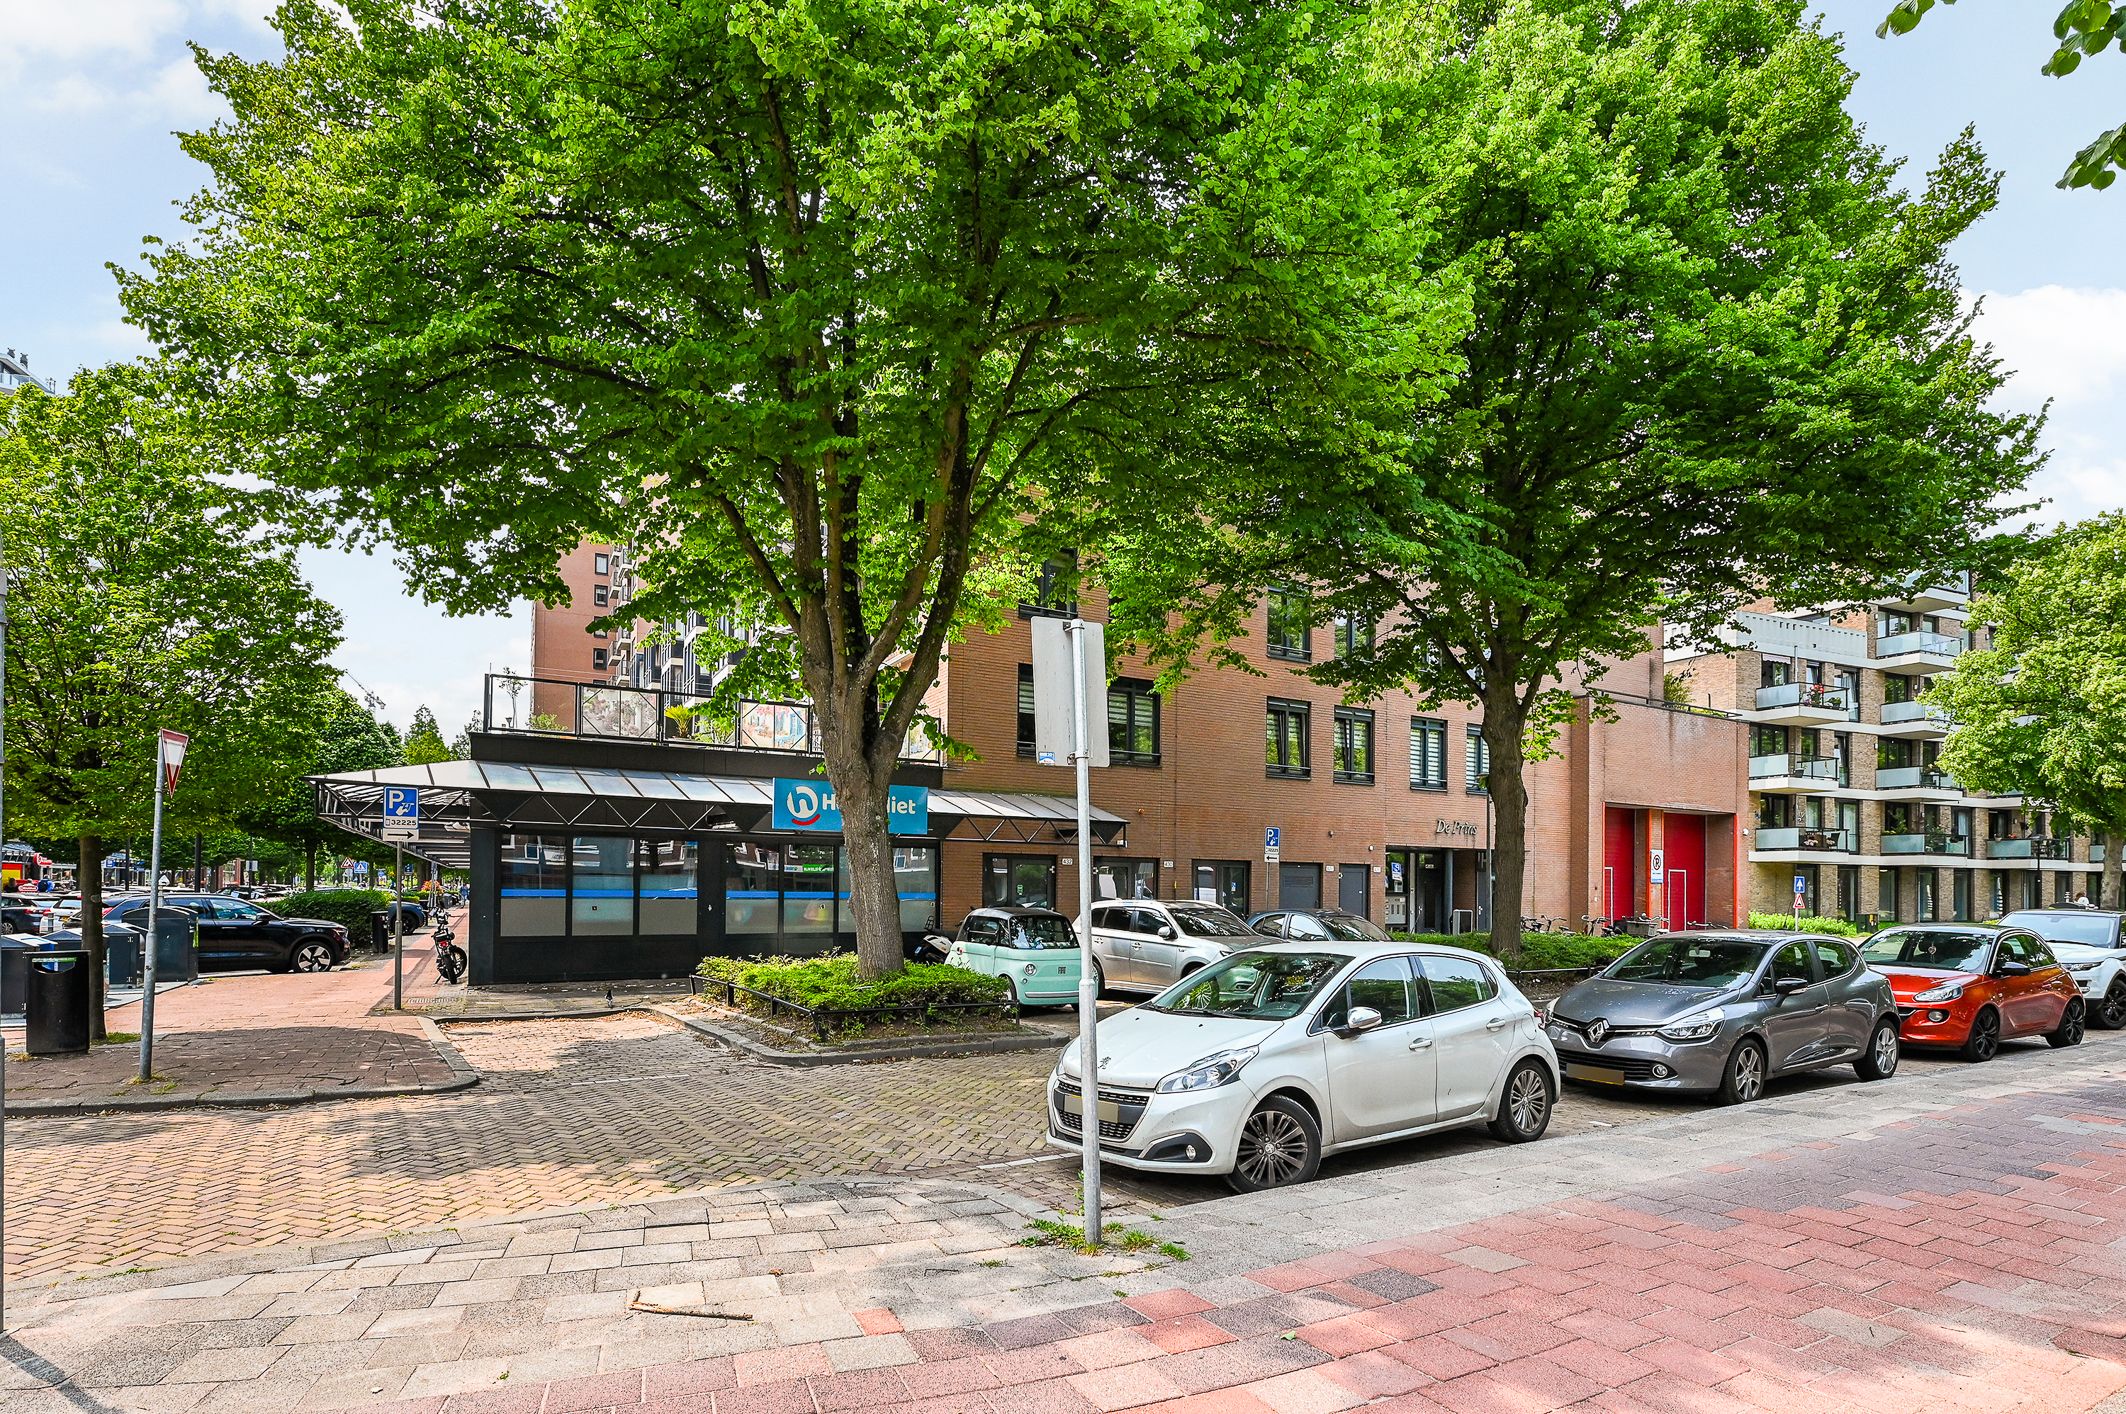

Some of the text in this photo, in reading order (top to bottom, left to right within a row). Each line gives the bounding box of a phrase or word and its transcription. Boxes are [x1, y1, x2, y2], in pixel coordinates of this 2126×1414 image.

[388, 790, 405, 809] P
[822, 793, 916, 814] Hliet
[1436, 819, 1450, 834] De
[1267, 829, 1274, 842] P
